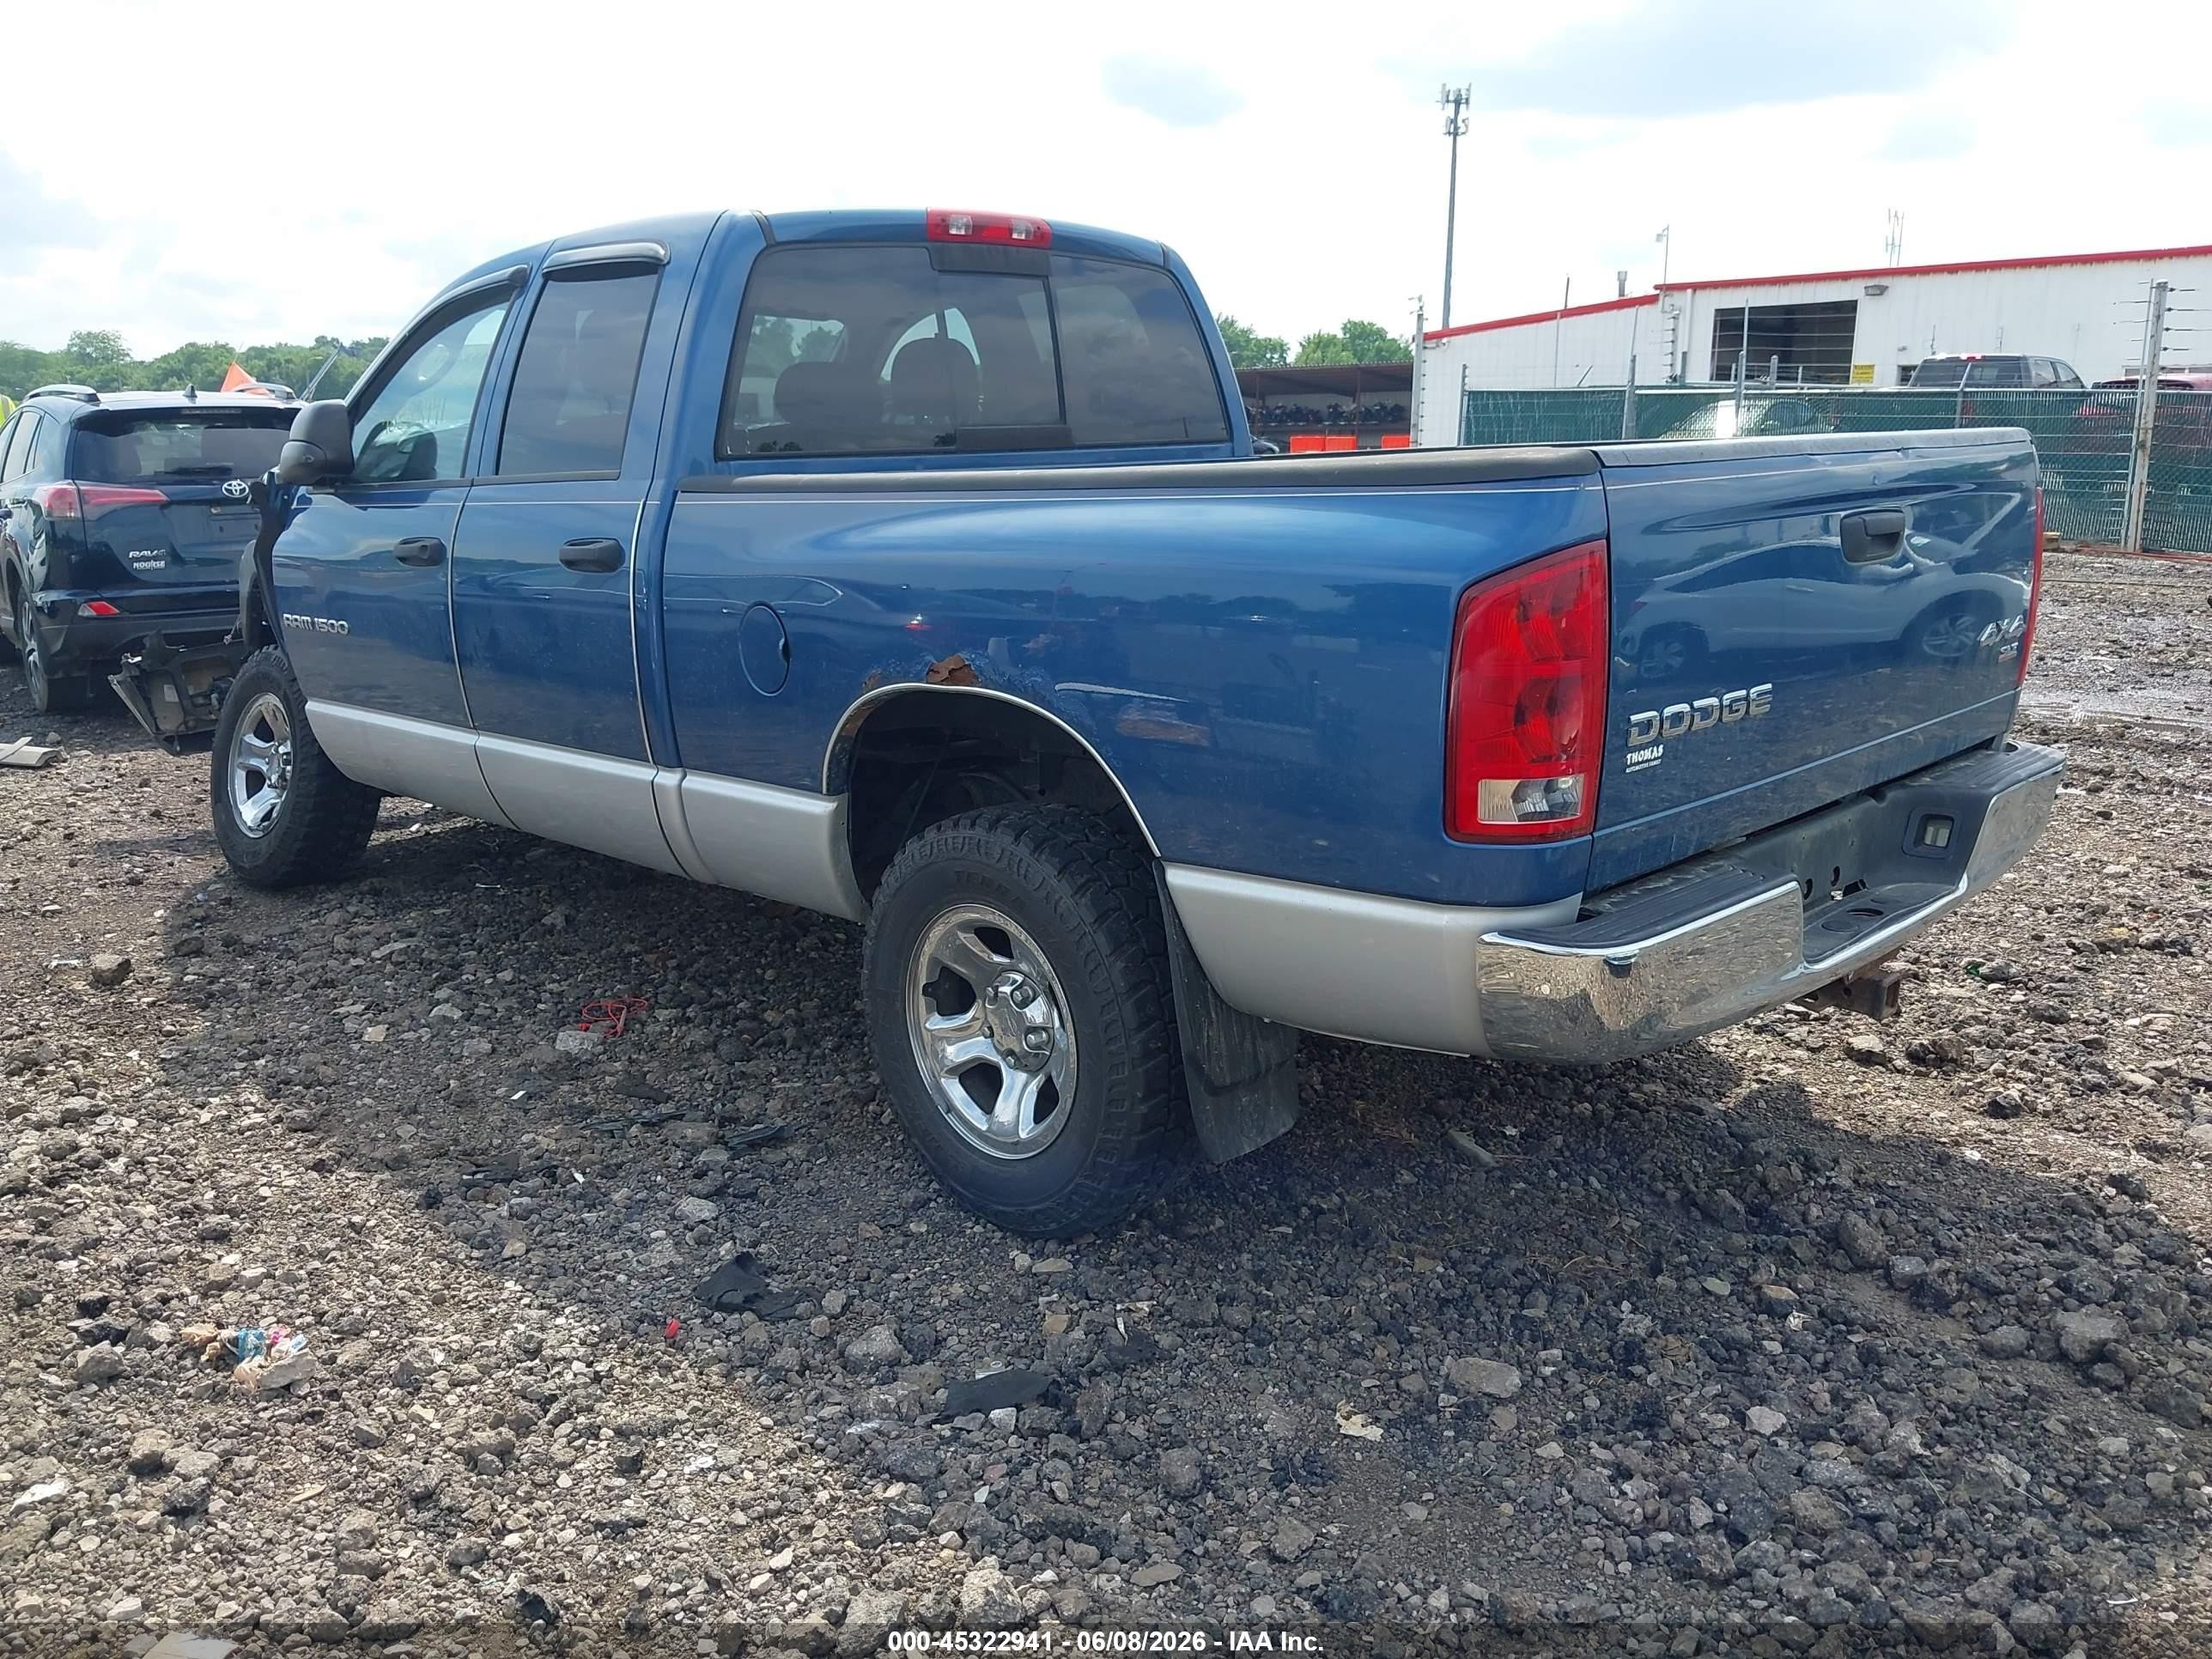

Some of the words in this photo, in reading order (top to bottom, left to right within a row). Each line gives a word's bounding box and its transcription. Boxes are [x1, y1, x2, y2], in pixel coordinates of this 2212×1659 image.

[129, 550, 166, 558] RAV4
[283, 613, 313, 630] RAM
[313, 617, 349, 635] 1500
[1627, 683, 1773, 747] DODGE
[1626, 744, 1664, 766] THOMAS
